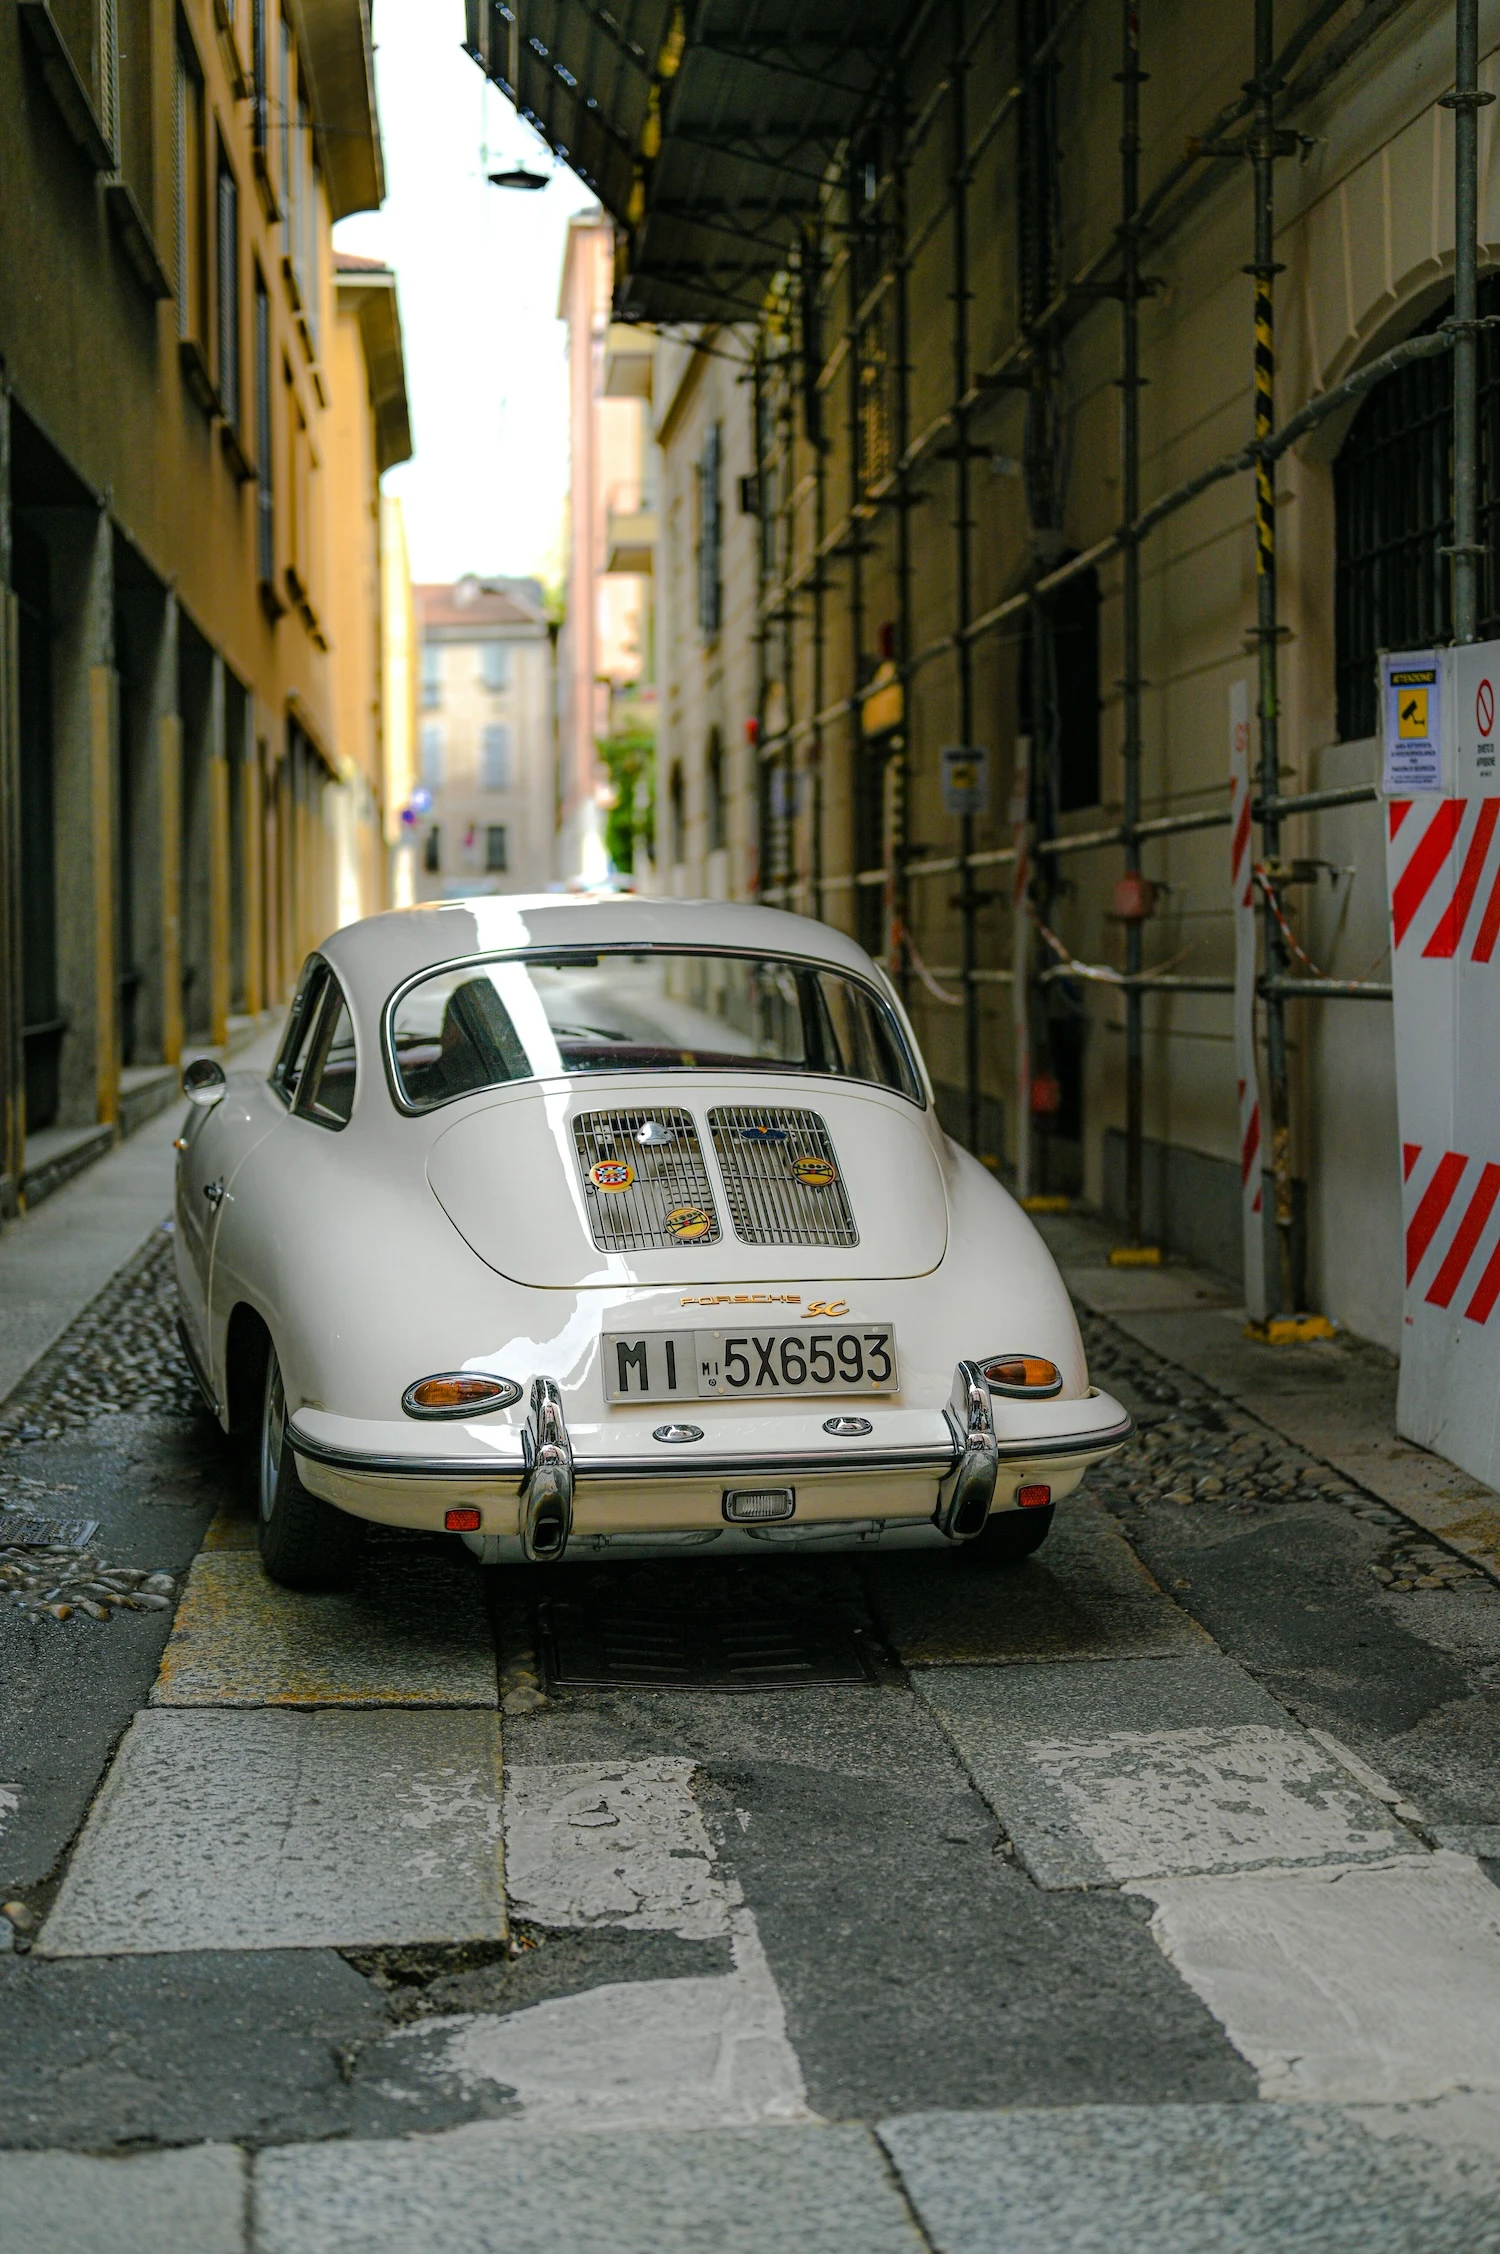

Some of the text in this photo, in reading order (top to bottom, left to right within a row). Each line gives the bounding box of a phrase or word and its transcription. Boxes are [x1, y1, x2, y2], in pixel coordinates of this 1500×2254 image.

[680, 1294, 850, 1318] PORSCHE SC
[724, 1334, 892, 1388] 5X6593
